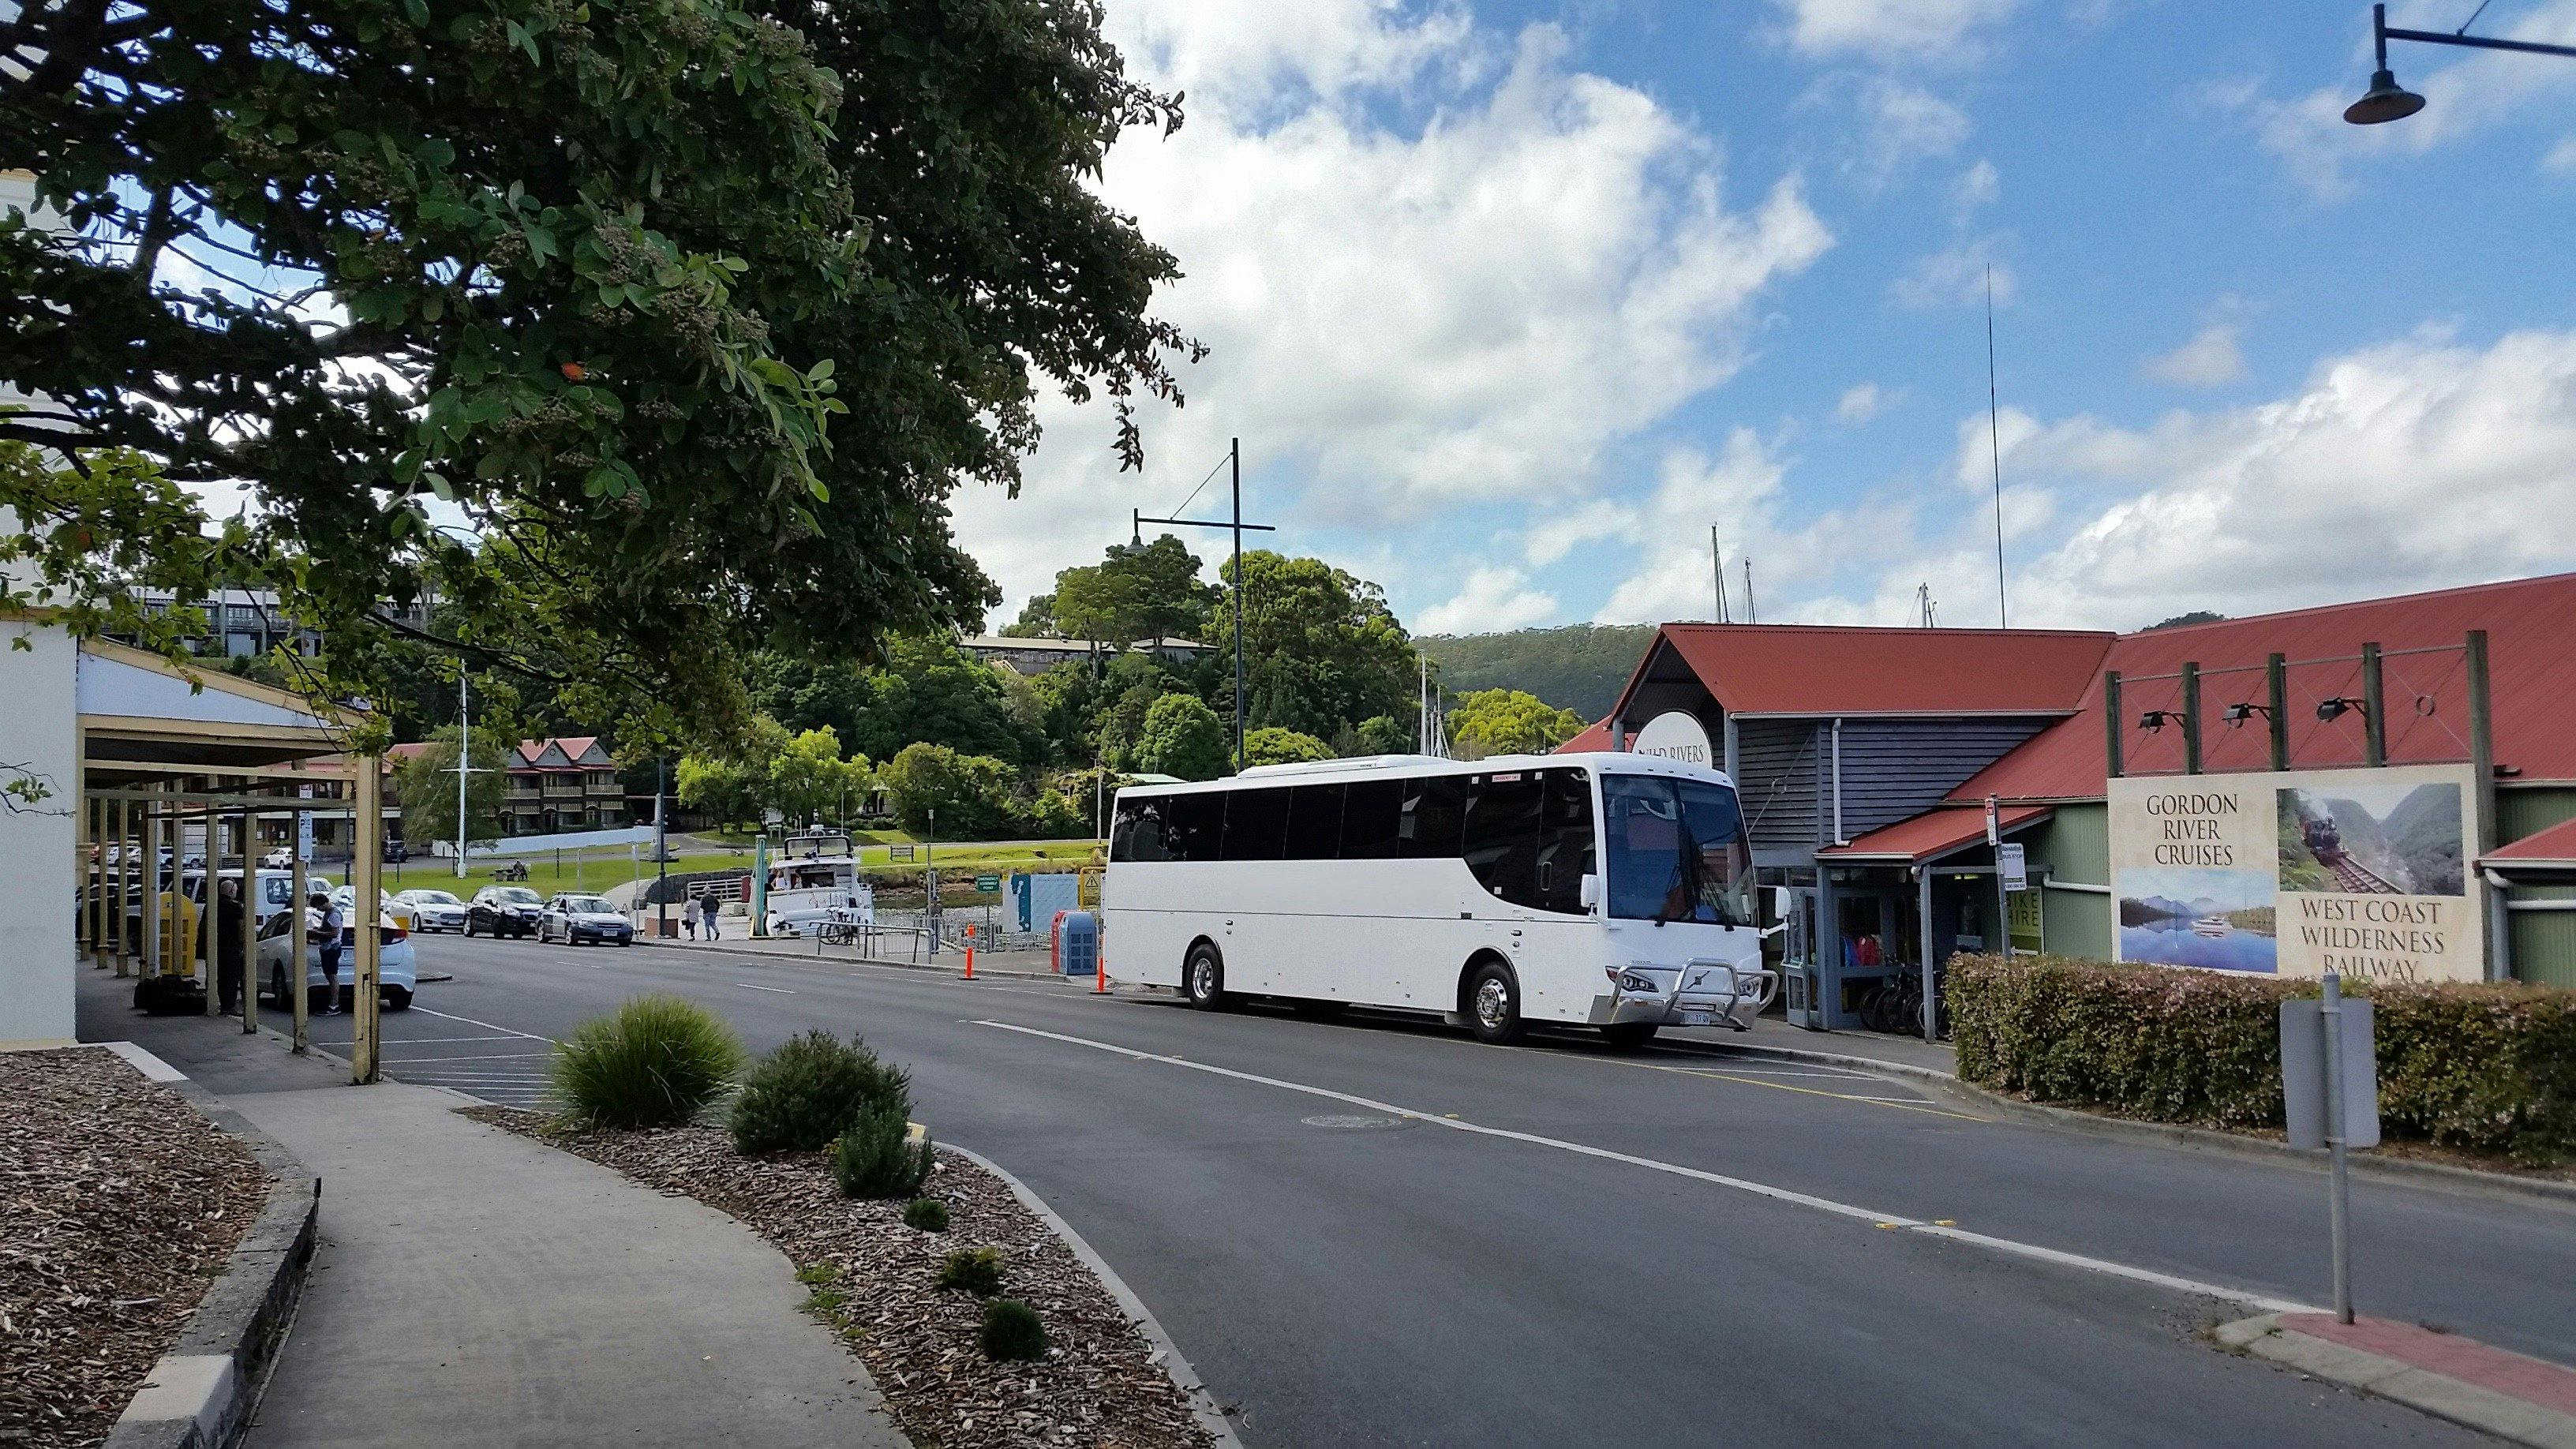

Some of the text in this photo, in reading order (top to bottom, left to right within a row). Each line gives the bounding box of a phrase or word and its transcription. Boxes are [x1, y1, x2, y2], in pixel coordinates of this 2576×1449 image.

[1670, 744, 1704, 762] RIVERS
[2147, 793, 2238, 815] GORDON
[2163, 819, 2221, 840] RIVER
[2155, 844, 2233, 866] CRUISES
[2301, 898, 2442, 924] WEST COAST
[2301, 925, 2445, 954] WILDERNESS
[2323, 954, 2419, 982] RAILWAY
